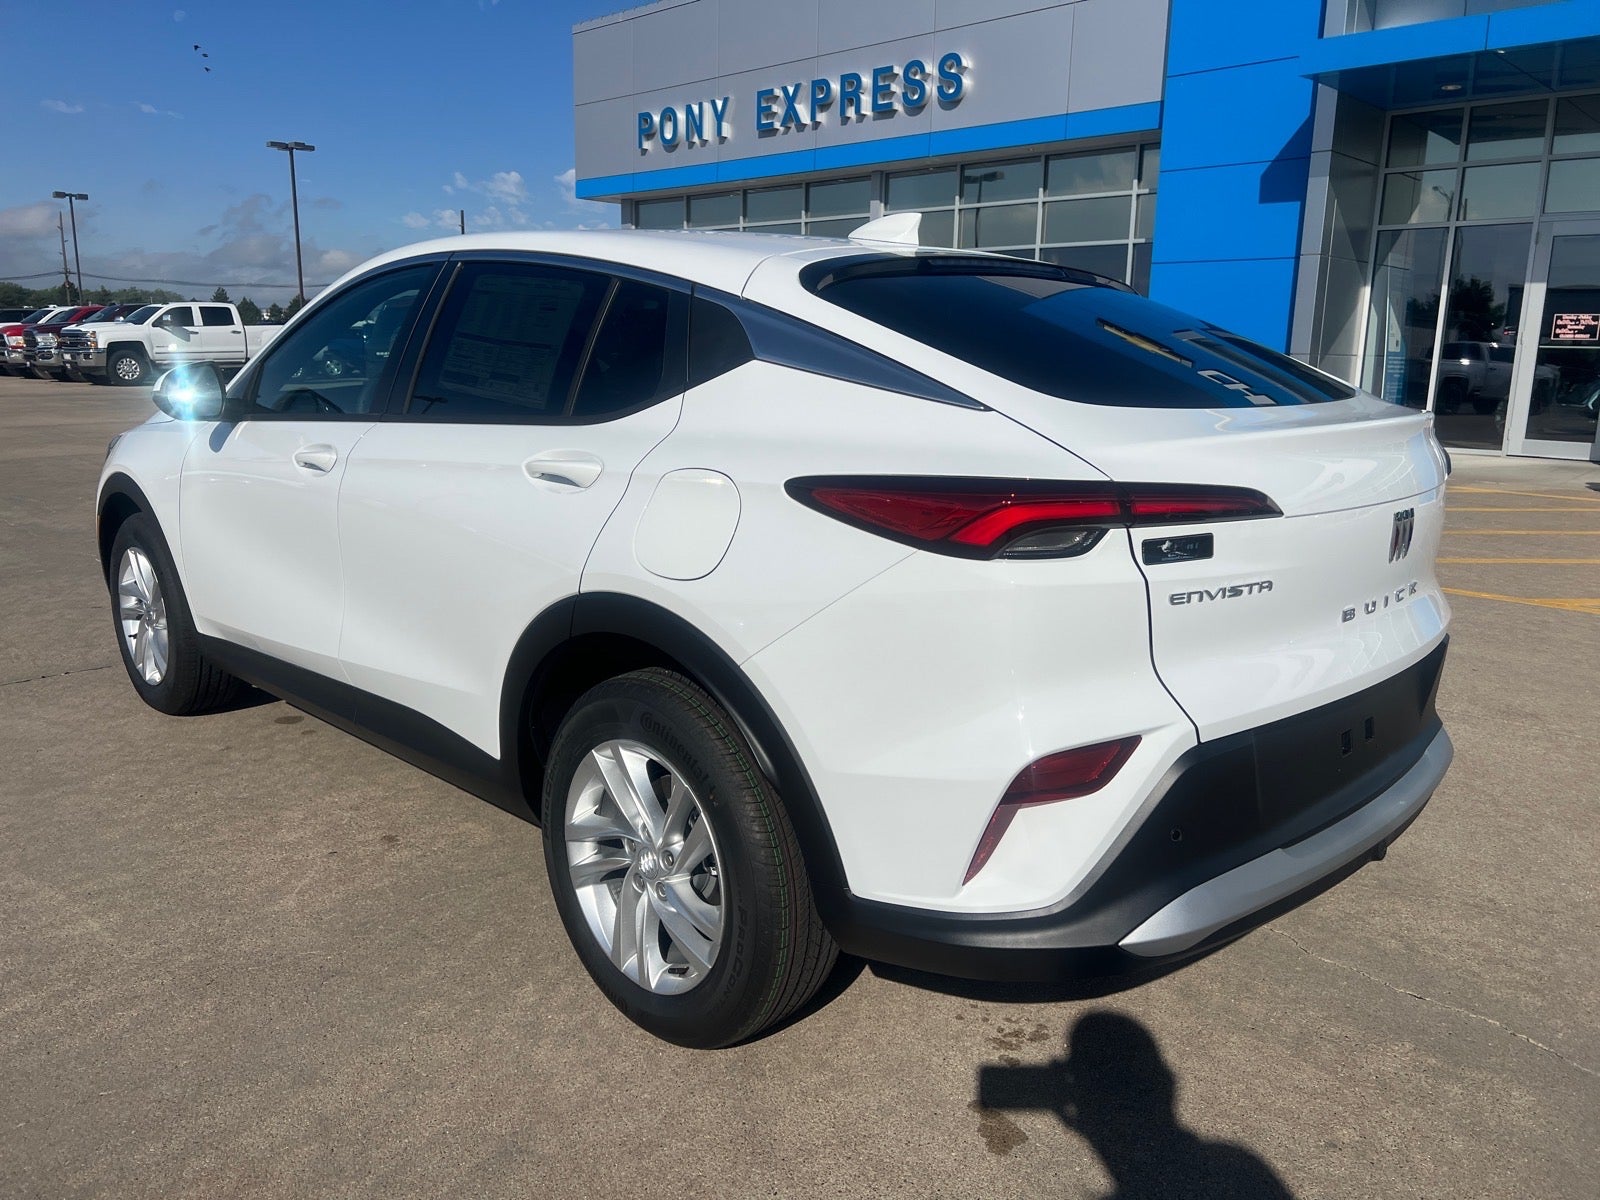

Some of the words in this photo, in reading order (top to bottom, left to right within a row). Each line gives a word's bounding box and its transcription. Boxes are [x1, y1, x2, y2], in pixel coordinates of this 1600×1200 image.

[638, 96, 731, 152] PONY
[756, 52, 966, 132] EXPRESS
[1169, 580, 1274, 606] ENVISTA
[1341, 581, 1418, 623] BUICK
